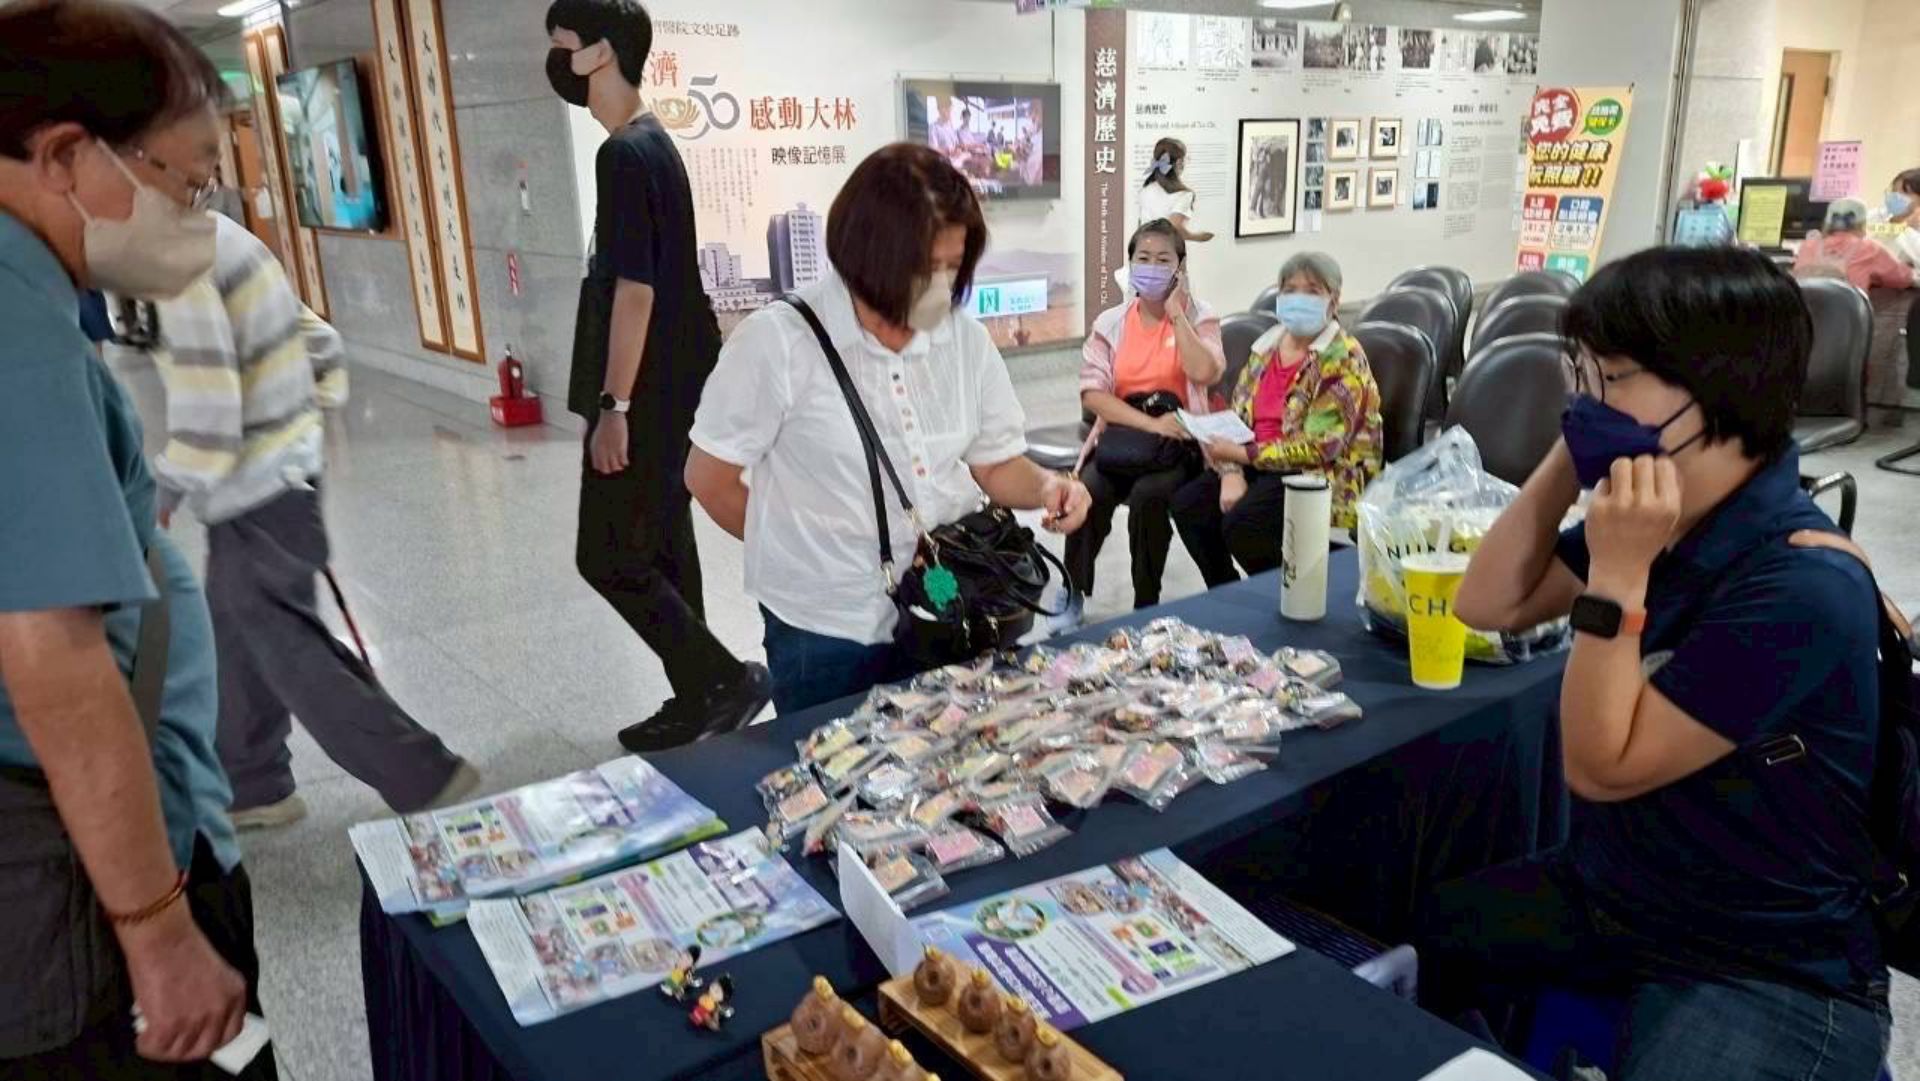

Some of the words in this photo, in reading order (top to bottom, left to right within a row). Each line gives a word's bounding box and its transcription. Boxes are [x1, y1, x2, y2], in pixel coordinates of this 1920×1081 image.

[749, 96, 856, 131] 感動大林
[1094, 47, 1117, 174] 慈濟歷史
[771, 145, 847, 166] 映像記憶展
[1533, 141, 1611, 164] 您的健康
